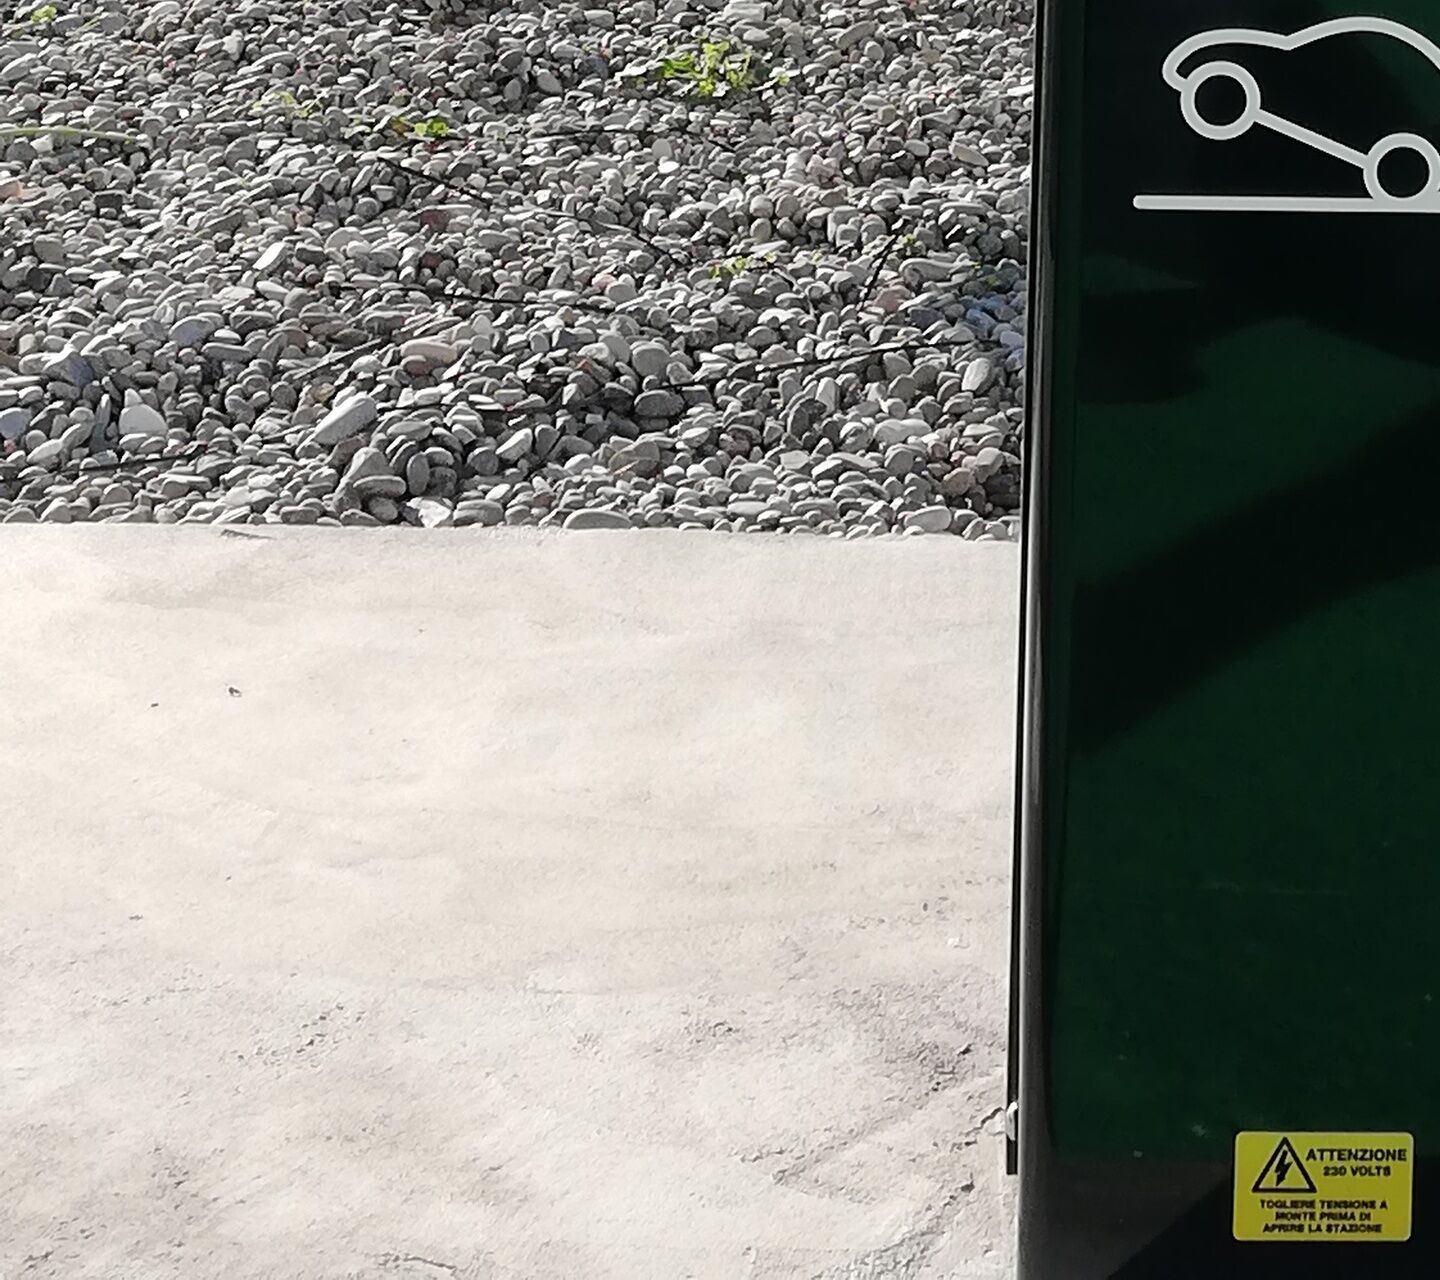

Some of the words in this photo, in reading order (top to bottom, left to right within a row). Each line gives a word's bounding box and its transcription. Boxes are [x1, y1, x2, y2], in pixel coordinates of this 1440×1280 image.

[1306, 1148, 1408, 1162] ATTENZIONE
[1323, 1165, 1347, 1177] 230
[1351, 1165, 1392, 1177] VOLTS
[1380, 1200, 1389, 1210] A
[1360, 1212, 1371, 1221] DI
[1308, 1223, 1322, 1233] LA
